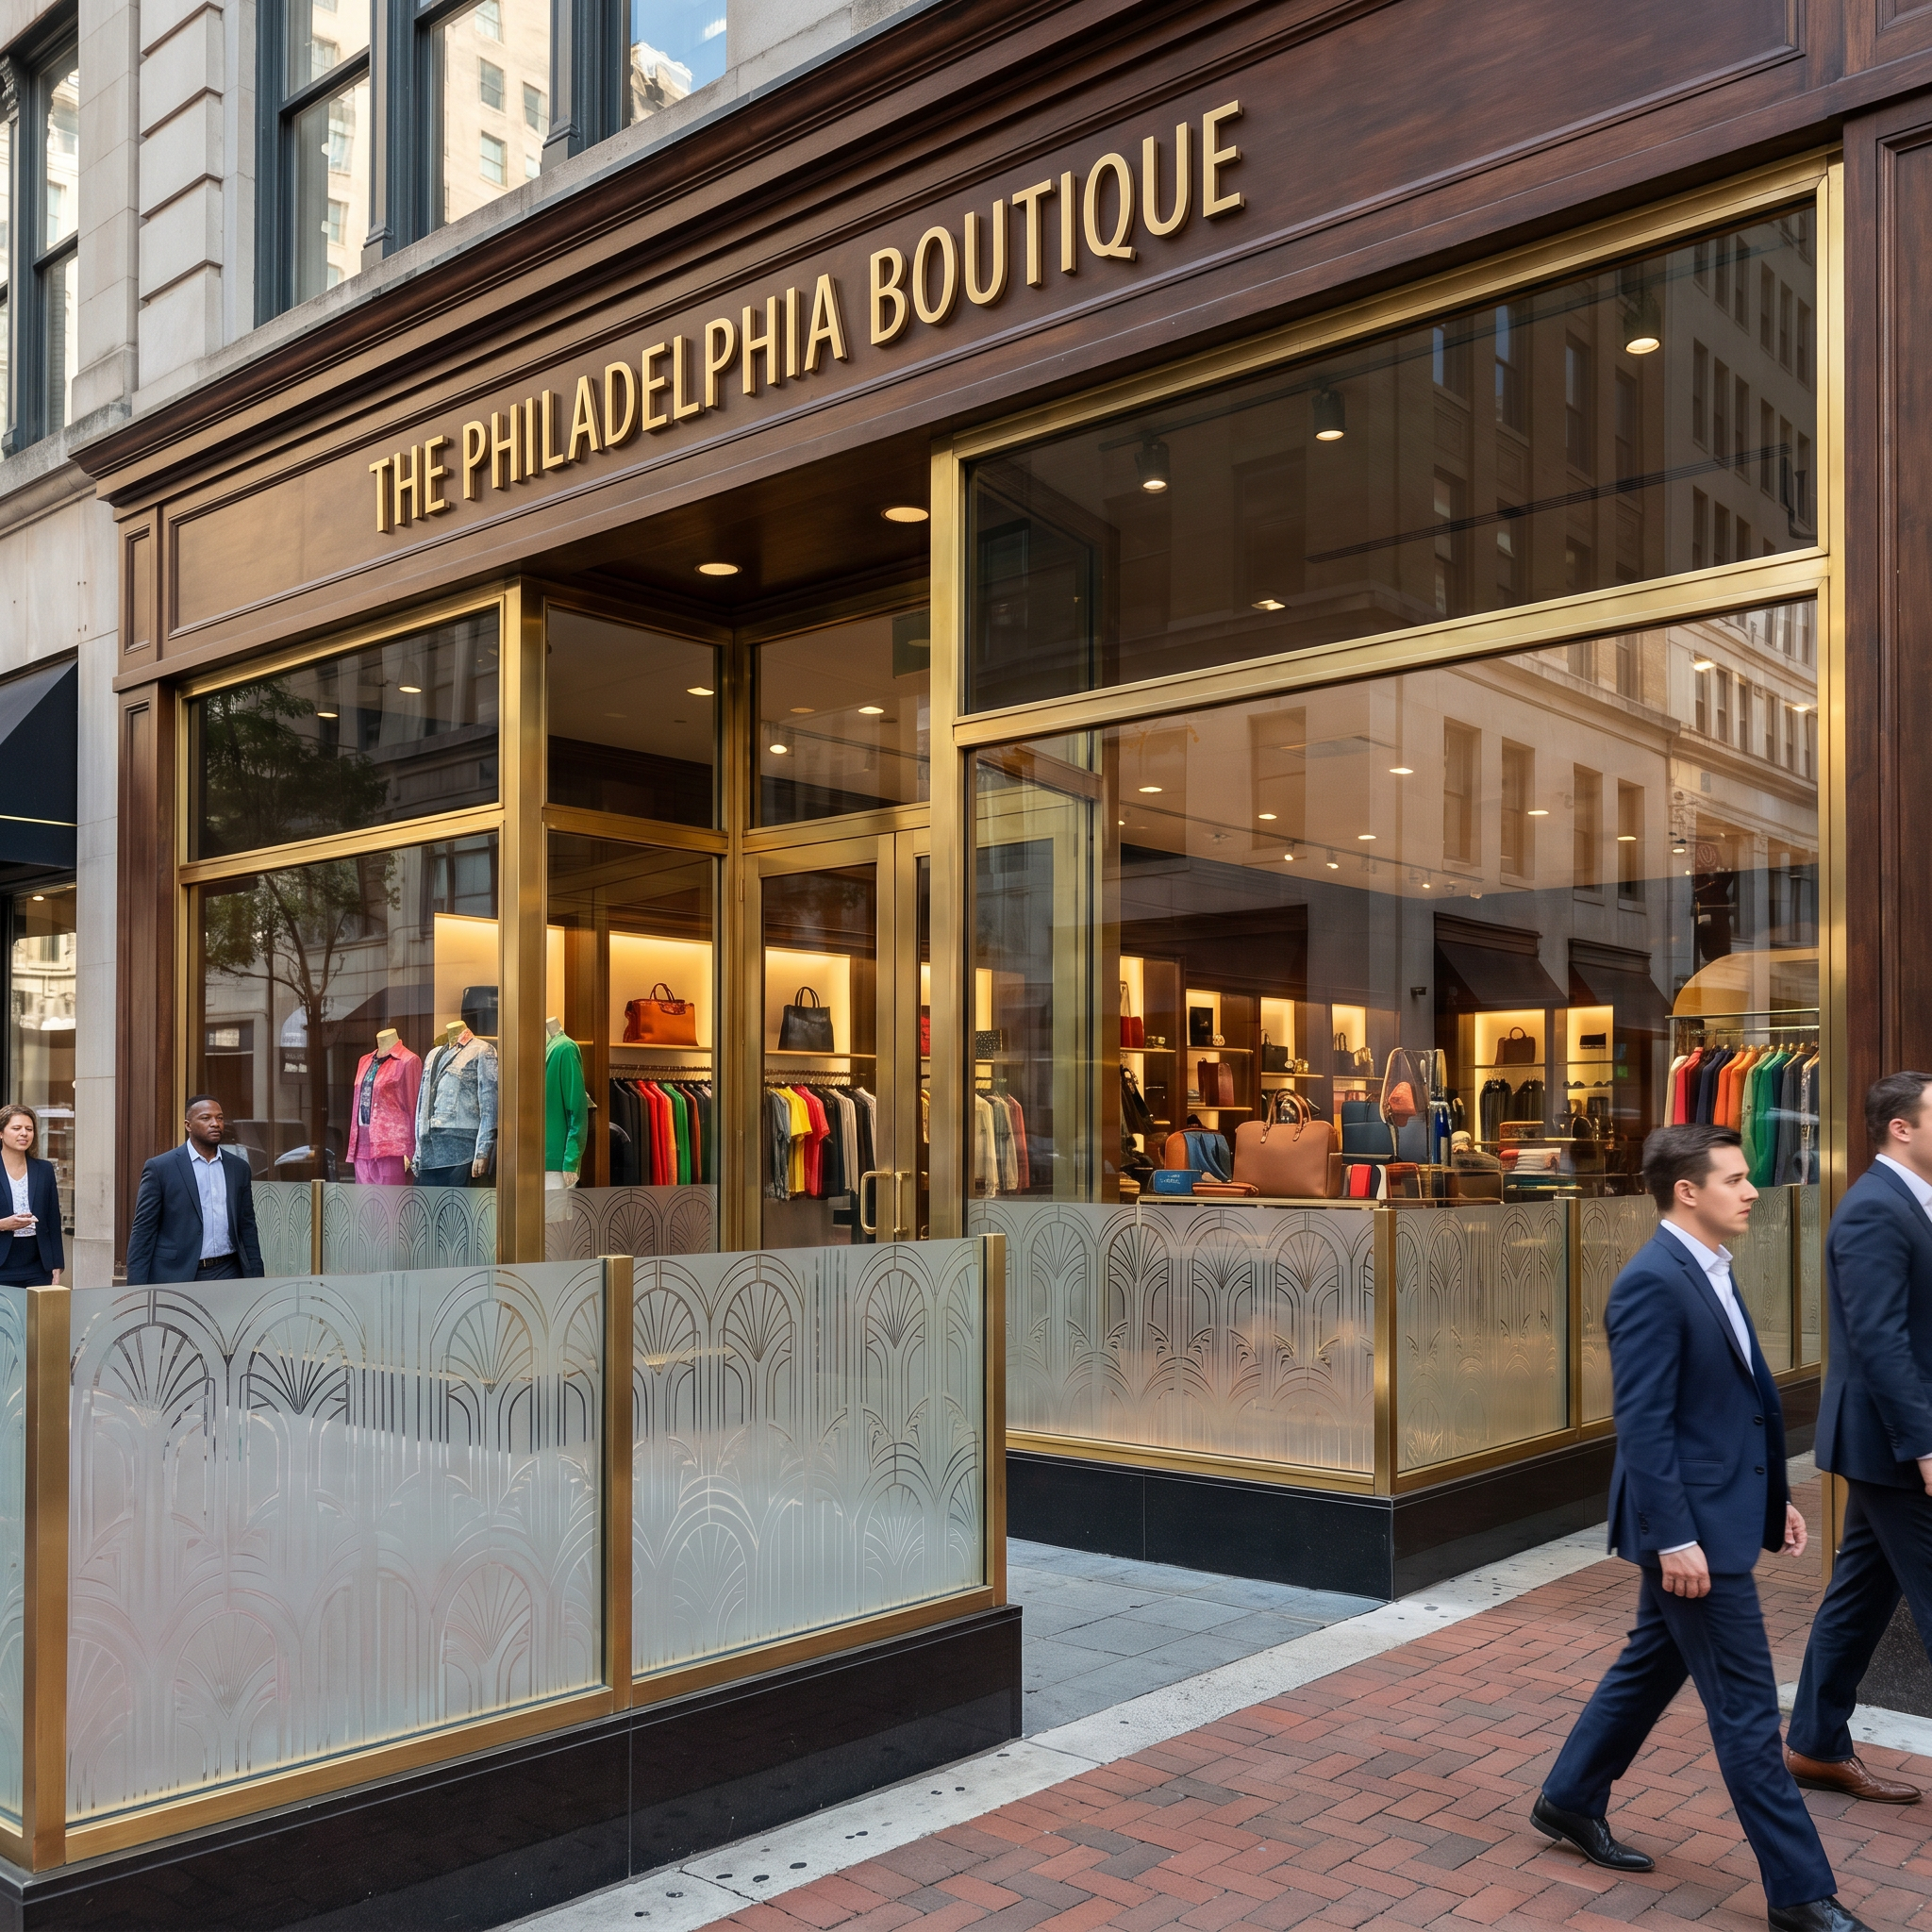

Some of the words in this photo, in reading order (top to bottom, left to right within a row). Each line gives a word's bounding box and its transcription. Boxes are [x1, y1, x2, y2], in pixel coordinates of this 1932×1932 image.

[369, 435, 450, 533] THE
[462, 274, 846, 499] PHILADELPHIA
[871, 100, 1244, 346] BOUTIQUE
